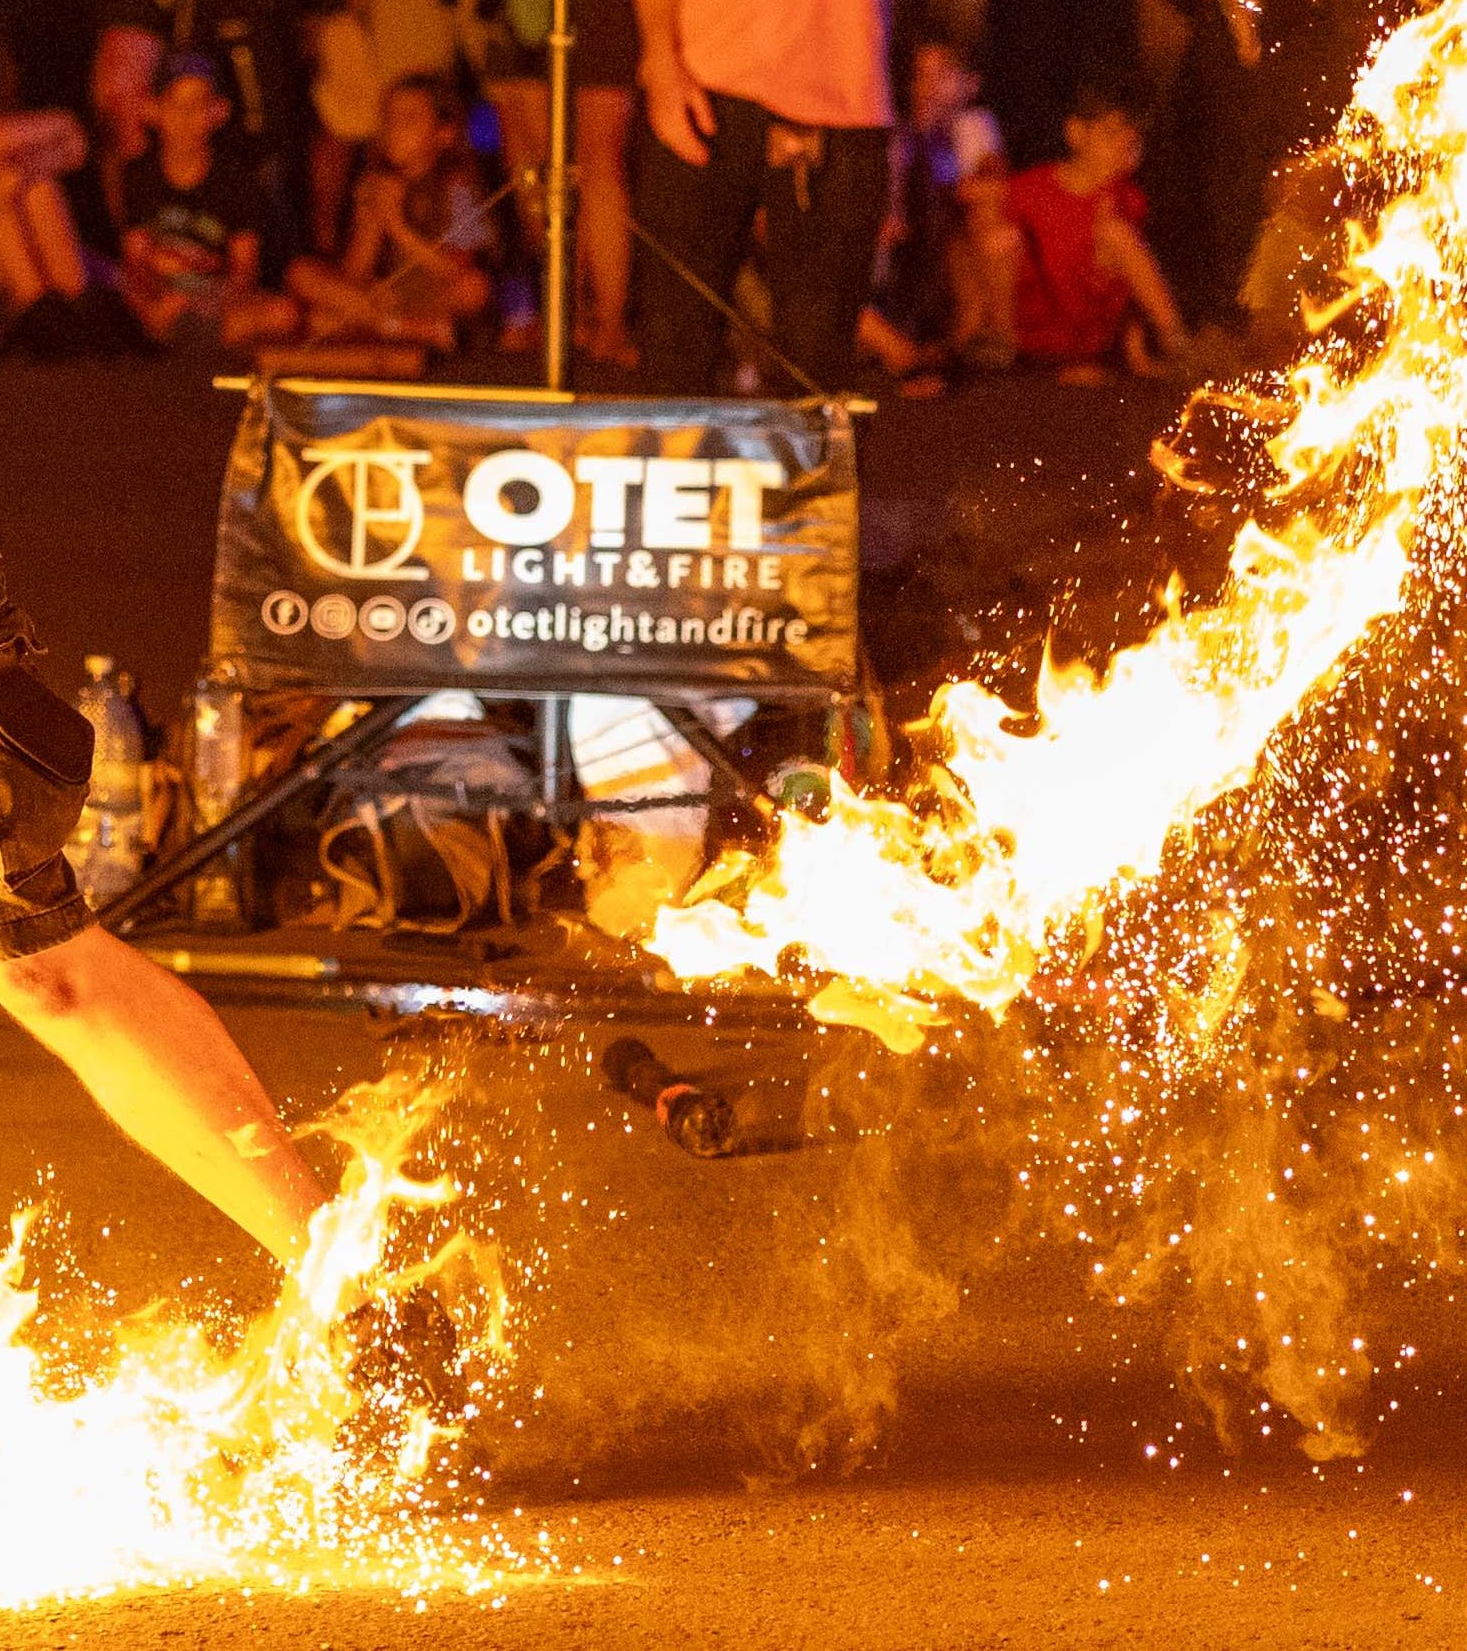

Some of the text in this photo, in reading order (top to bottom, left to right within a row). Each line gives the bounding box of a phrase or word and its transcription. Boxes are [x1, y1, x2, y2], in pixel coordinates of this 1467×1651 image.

[463, 449, 786, 550] OTET
[461, 547, 784, 590] LIGHT&FIRE
[467, 602, 809, 652] otetlightandfire
